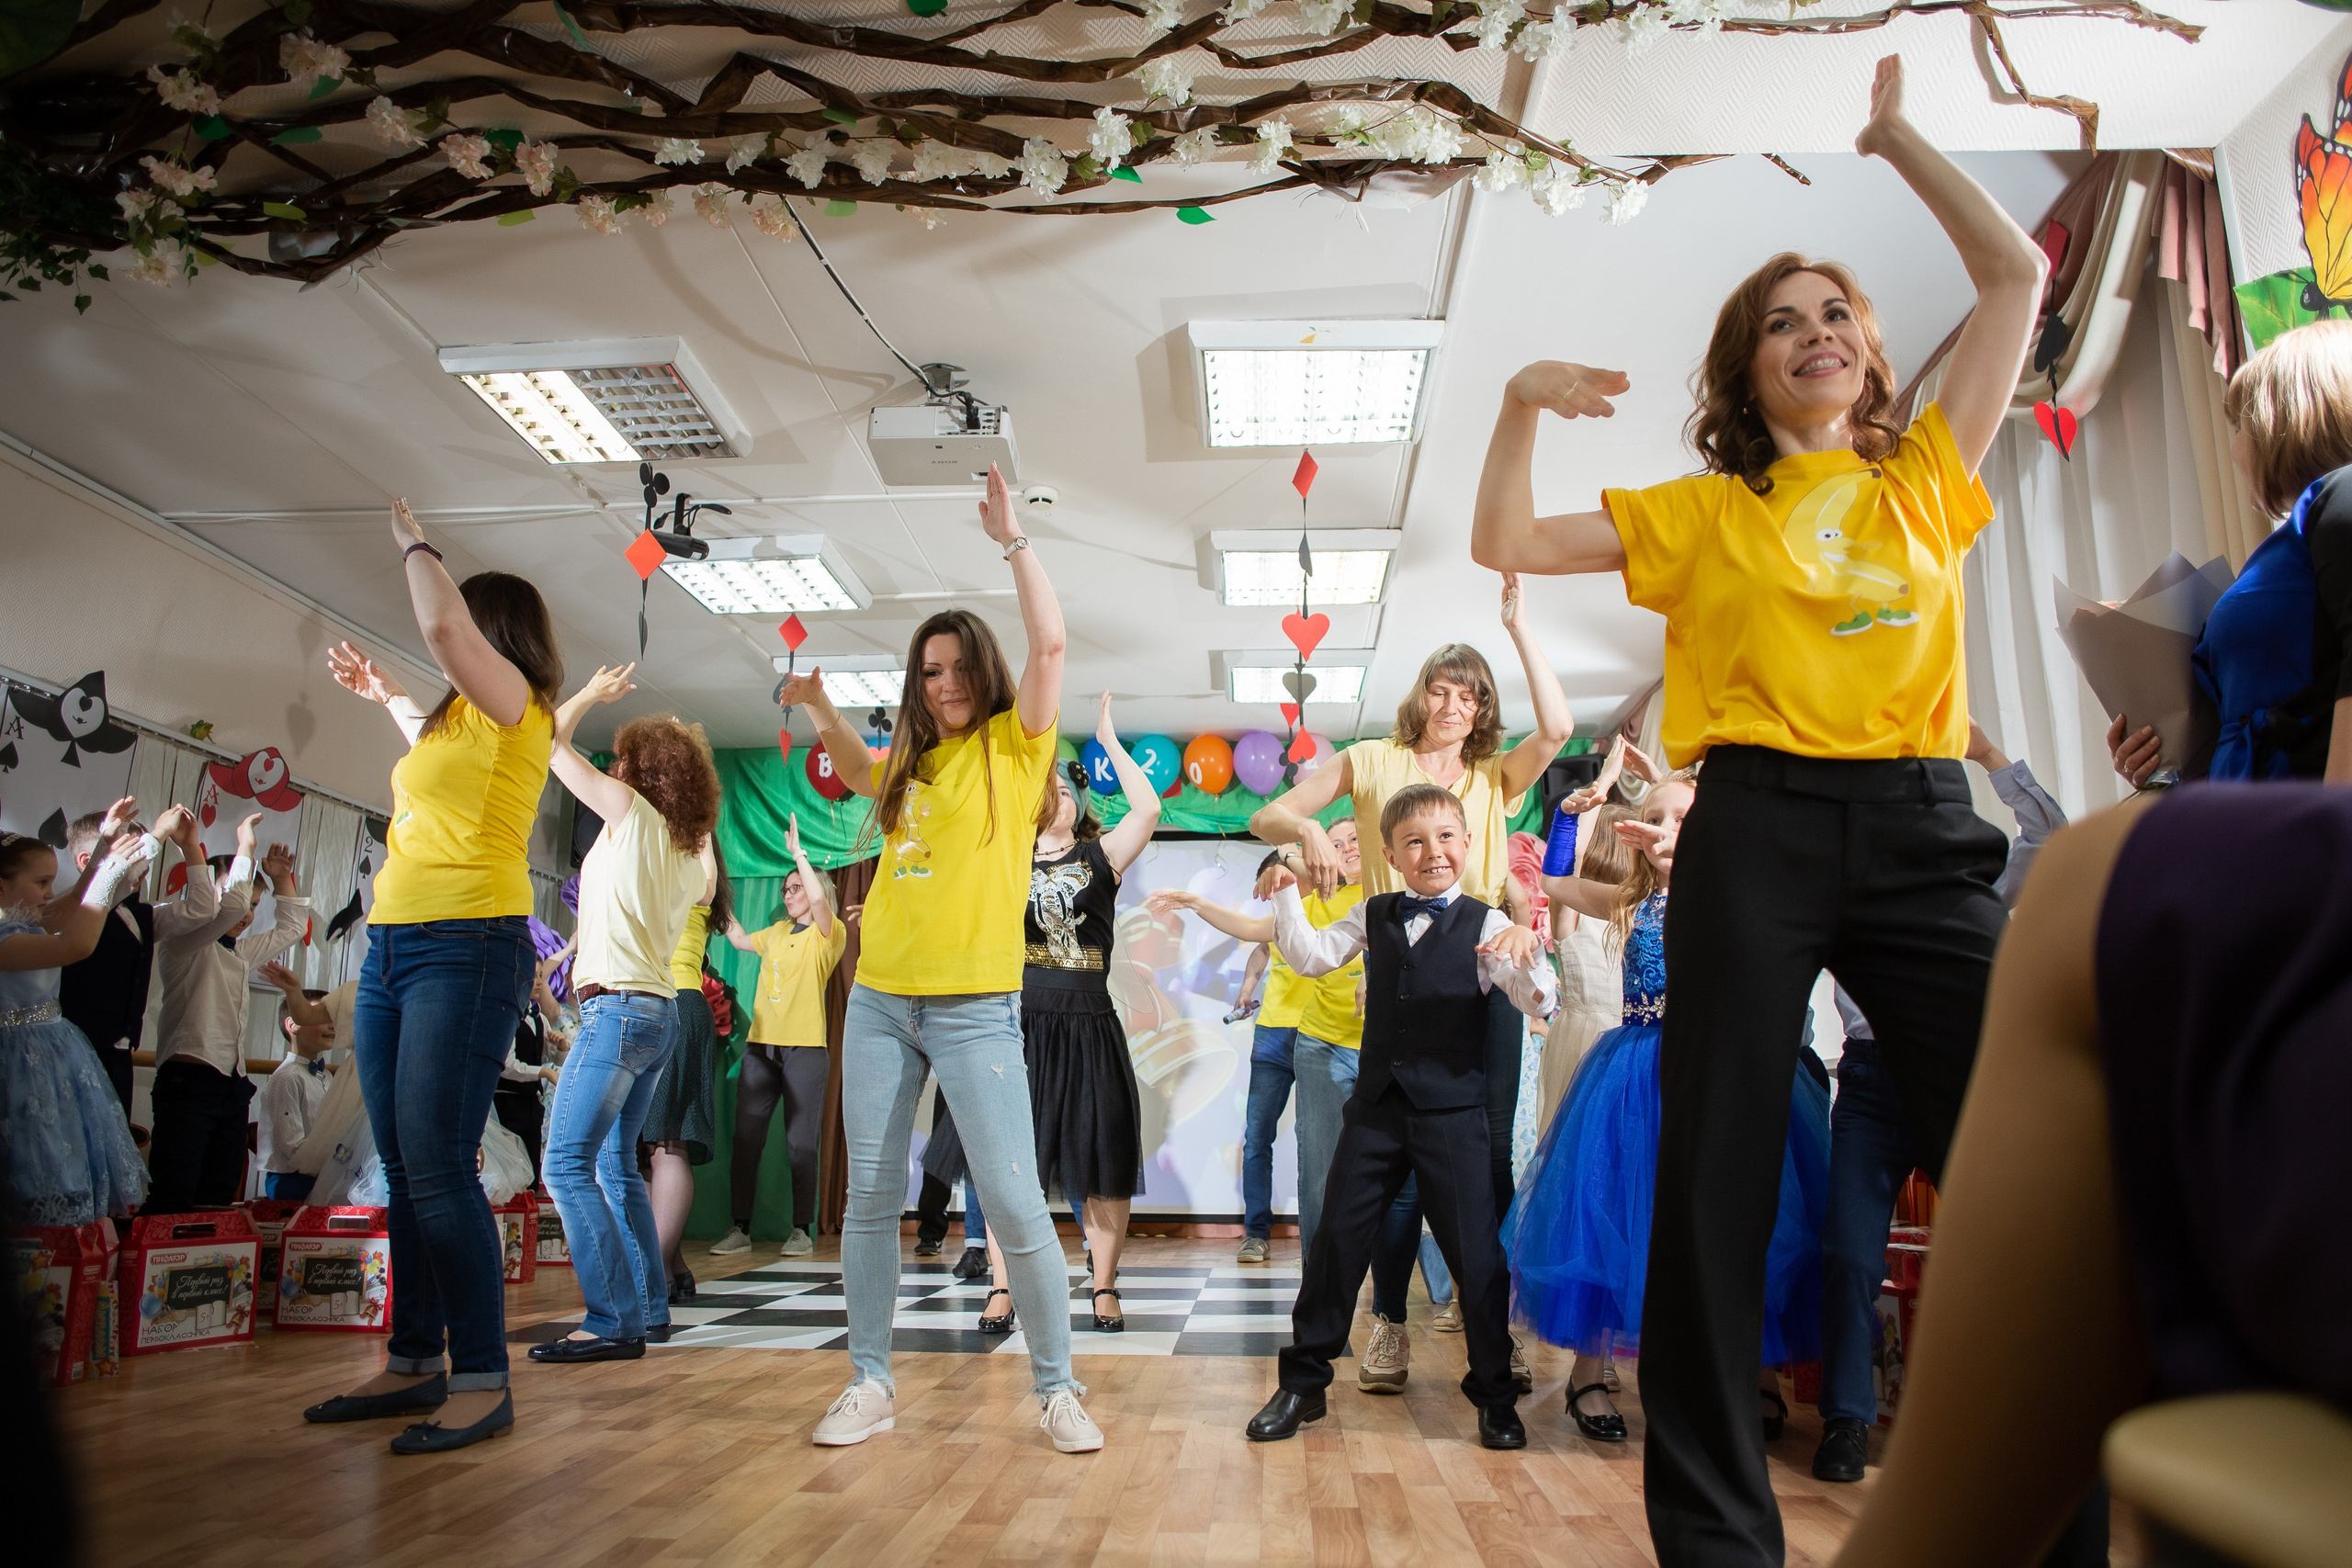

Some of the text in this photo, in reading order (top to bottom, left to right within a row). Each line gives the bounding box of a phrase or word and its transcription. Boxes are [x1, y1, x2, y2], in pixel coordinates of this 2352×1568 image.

[5, 716, 25, 740] A
[1139, 748, 1157, 775] 2
[203, 784, 220, 805] A
[364, 836, 374, 853] 2
[289, 1242, 321, 1251] ПИФАГОР
[152, 1253, 187, 1265] ПИФАГОР
[281, 1304, 314, 1314] НАБОР
[141, 1323, 178, 1336] НАБОР
[141, 1329, 211, 1345] ПЕРВОКЛАССНИКА
